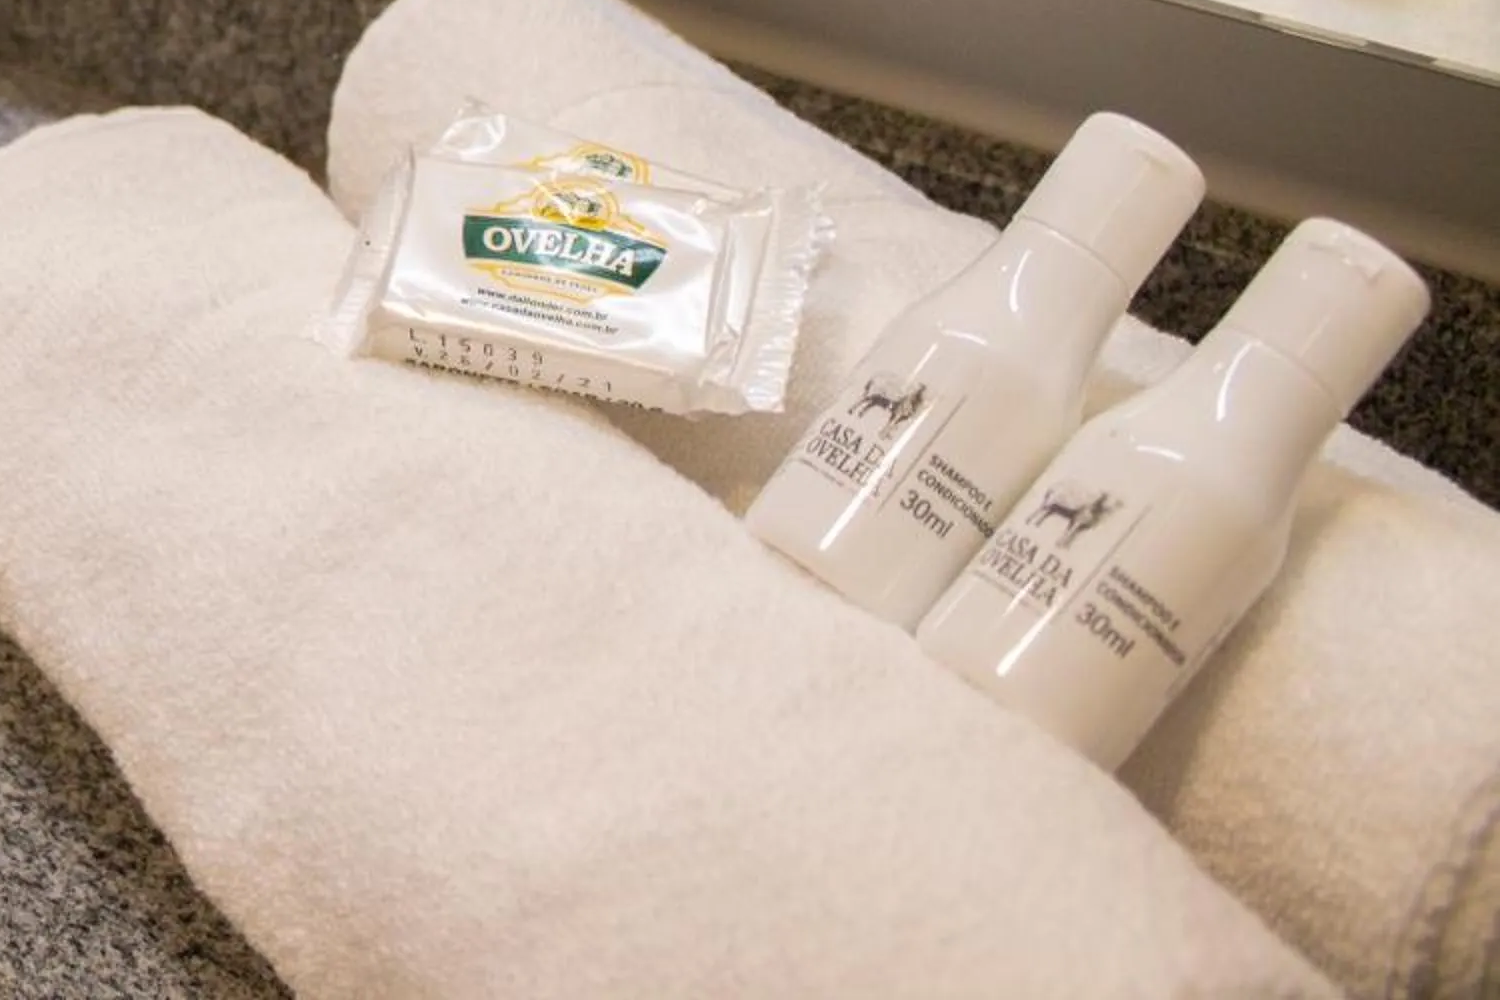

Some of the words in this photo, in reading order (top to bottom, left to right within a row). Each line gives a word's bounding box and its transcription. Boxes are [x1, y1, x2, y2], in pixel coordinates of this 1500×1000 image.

[483, 227, 635, 277] OVELHA
[819, 417, 864, 454] CASA
[900, 489, 956, 538] 30ml
[1039, 552, 1074, 589] DA
[1075, 602, 1137, 660] 30ml
